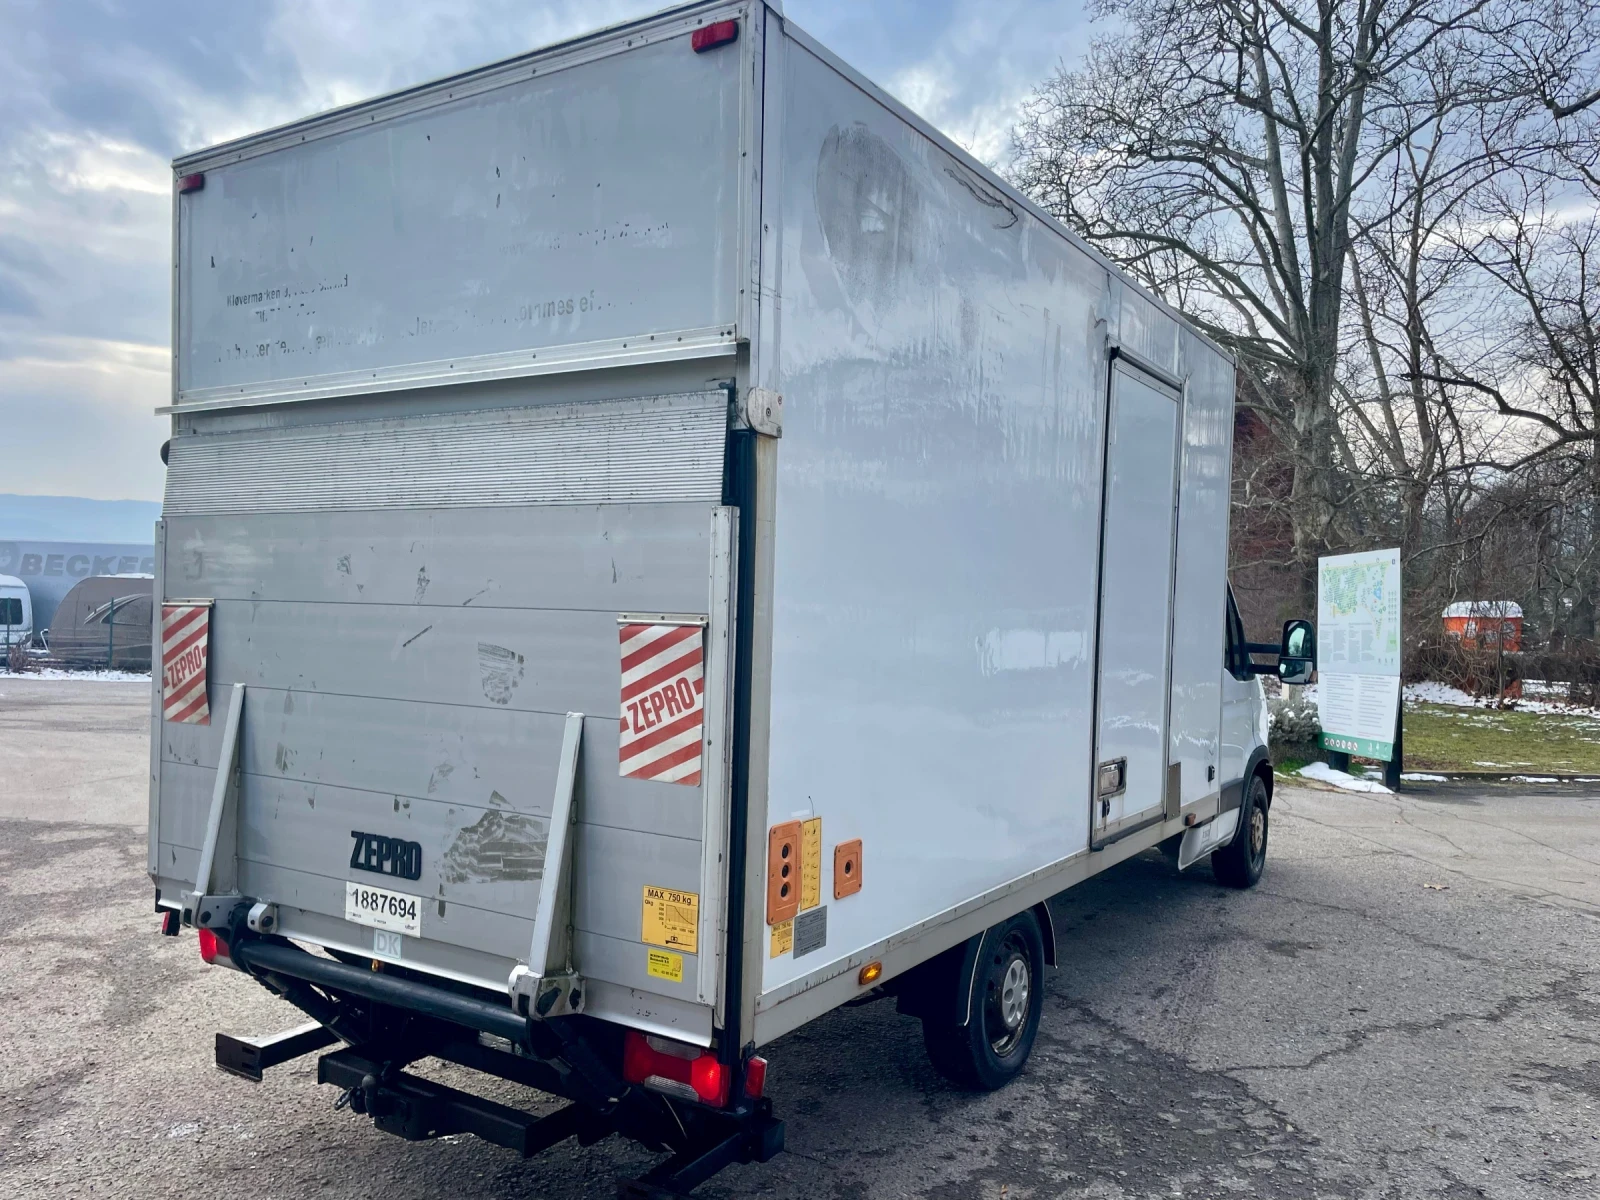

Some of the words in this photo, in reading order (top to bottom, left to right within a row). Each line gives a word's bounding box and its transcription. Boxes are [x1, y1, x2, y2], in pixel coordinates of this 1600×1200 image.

[167, 644, 202, 689] ZEPRO
[626, 677, 695, 735] ZEPRO
[350, 830, 422, 881] ZEPRO
[352, 888, 416, 920] 1887694
[647, 888, 665, 899] MAX
[668, 892, 681, 902] 750
[682, 895, 692, 906] kg
[376, 933, 399, 956] DK
